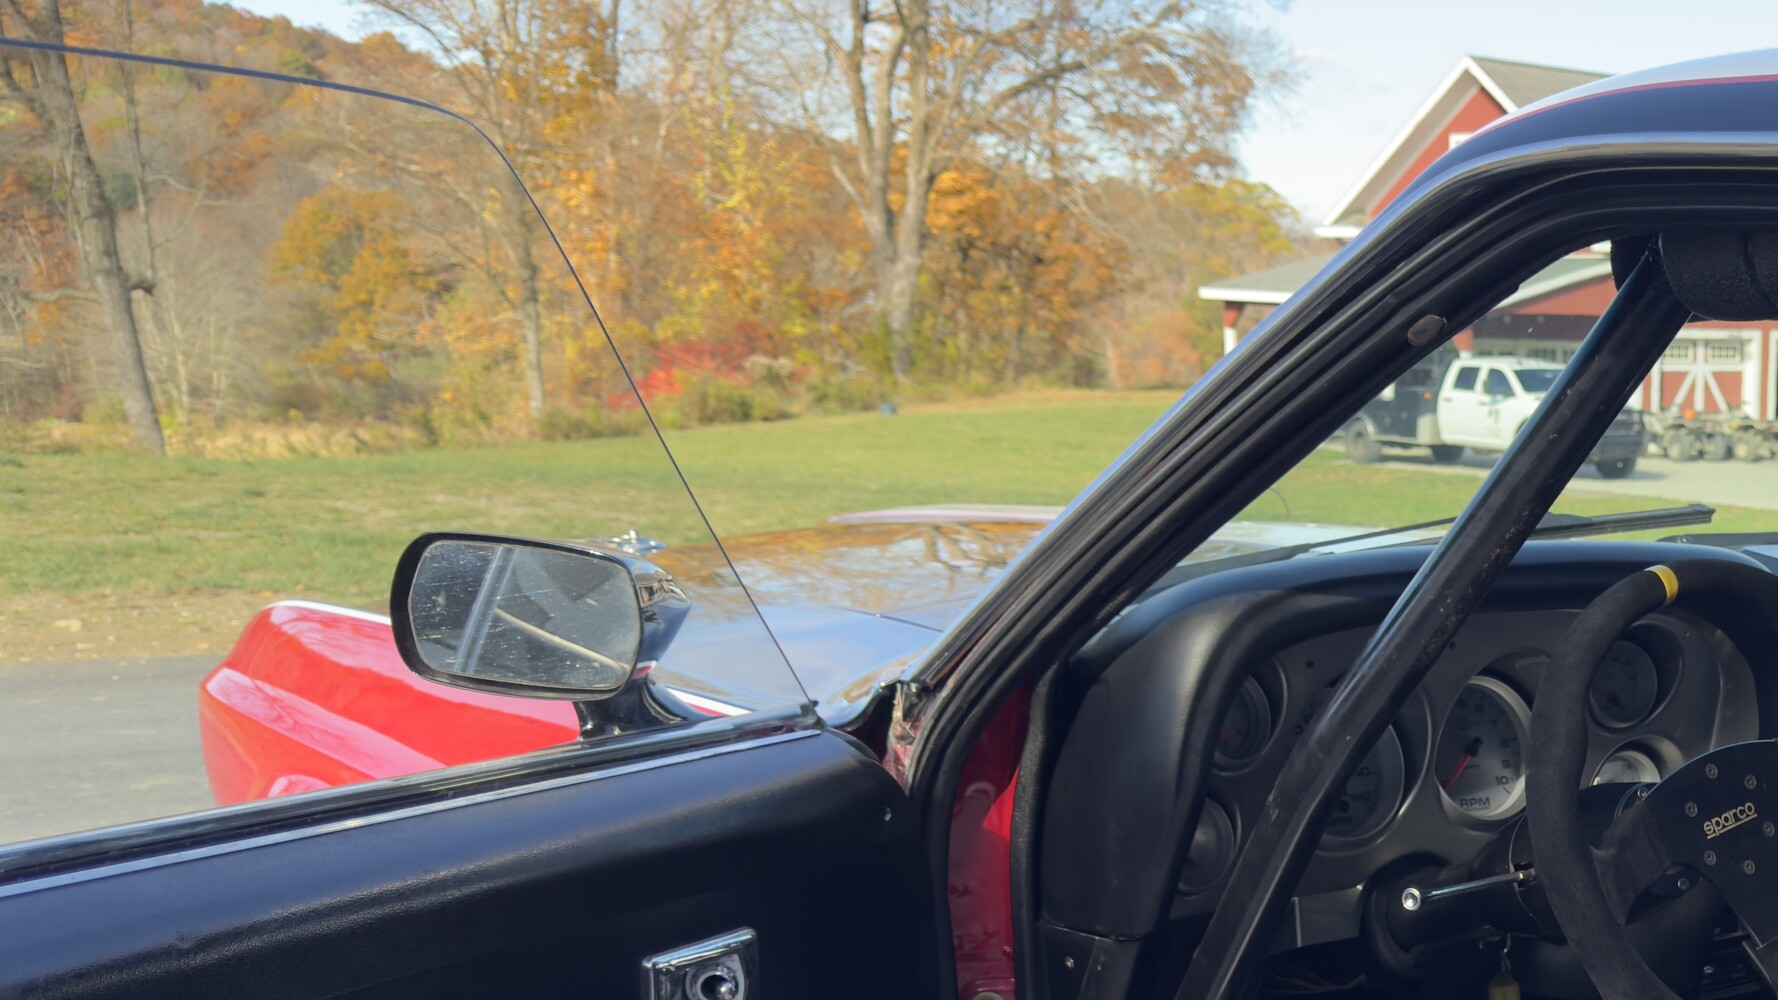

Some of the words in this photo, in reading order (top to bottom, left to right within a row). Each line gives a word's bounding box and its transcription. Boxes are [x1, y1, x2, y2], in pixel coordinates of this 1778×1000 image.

[1502, 759, 1511, 769] 9
[1495, 775, 1509, 786] 10
[1460, 797, 1491, 809] RPM
[1703, 802, 1756, 838] sparco
